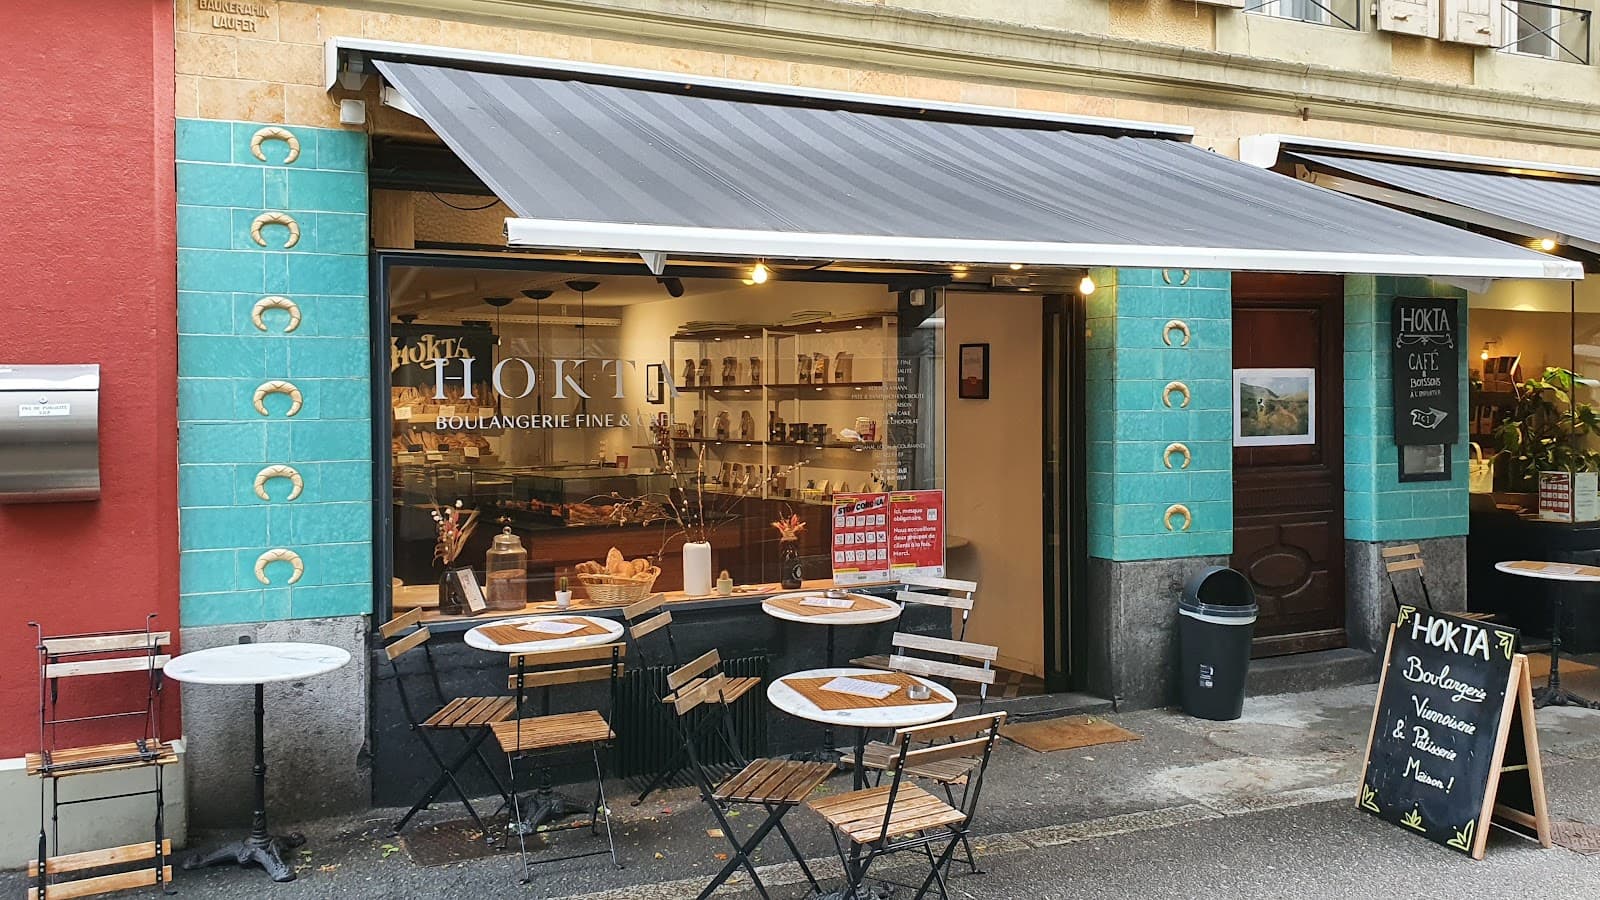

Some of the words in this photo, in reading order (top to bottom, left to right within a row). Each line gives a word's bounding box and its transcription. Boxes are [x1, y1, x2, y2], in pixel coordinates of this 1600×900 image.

[1400, 307, 1450, 332] HOKTA
[1408, 349, 1439, 371] CAFÉ
[432, 357, 680, 400] HOKTA
[1410, 377, 1441, 388] BOISSONS
[436, 413, 571, 429] BOULANGERIE
[576, 413, 615, 428] FINE
[620, 413, 632, 427] &
[1417, 413, 1431, 423] ICI
[1411, 612, 1490, 661] HOKTA
[1403, 655, 1487, 702] Boulangerie
[1411, 694, 1477, 735] Viennoiserie
[1392, 719, 1406, 740] &
[1402, 756, 1444, 789] Maison
[1445, 776, 1455, 794] !
